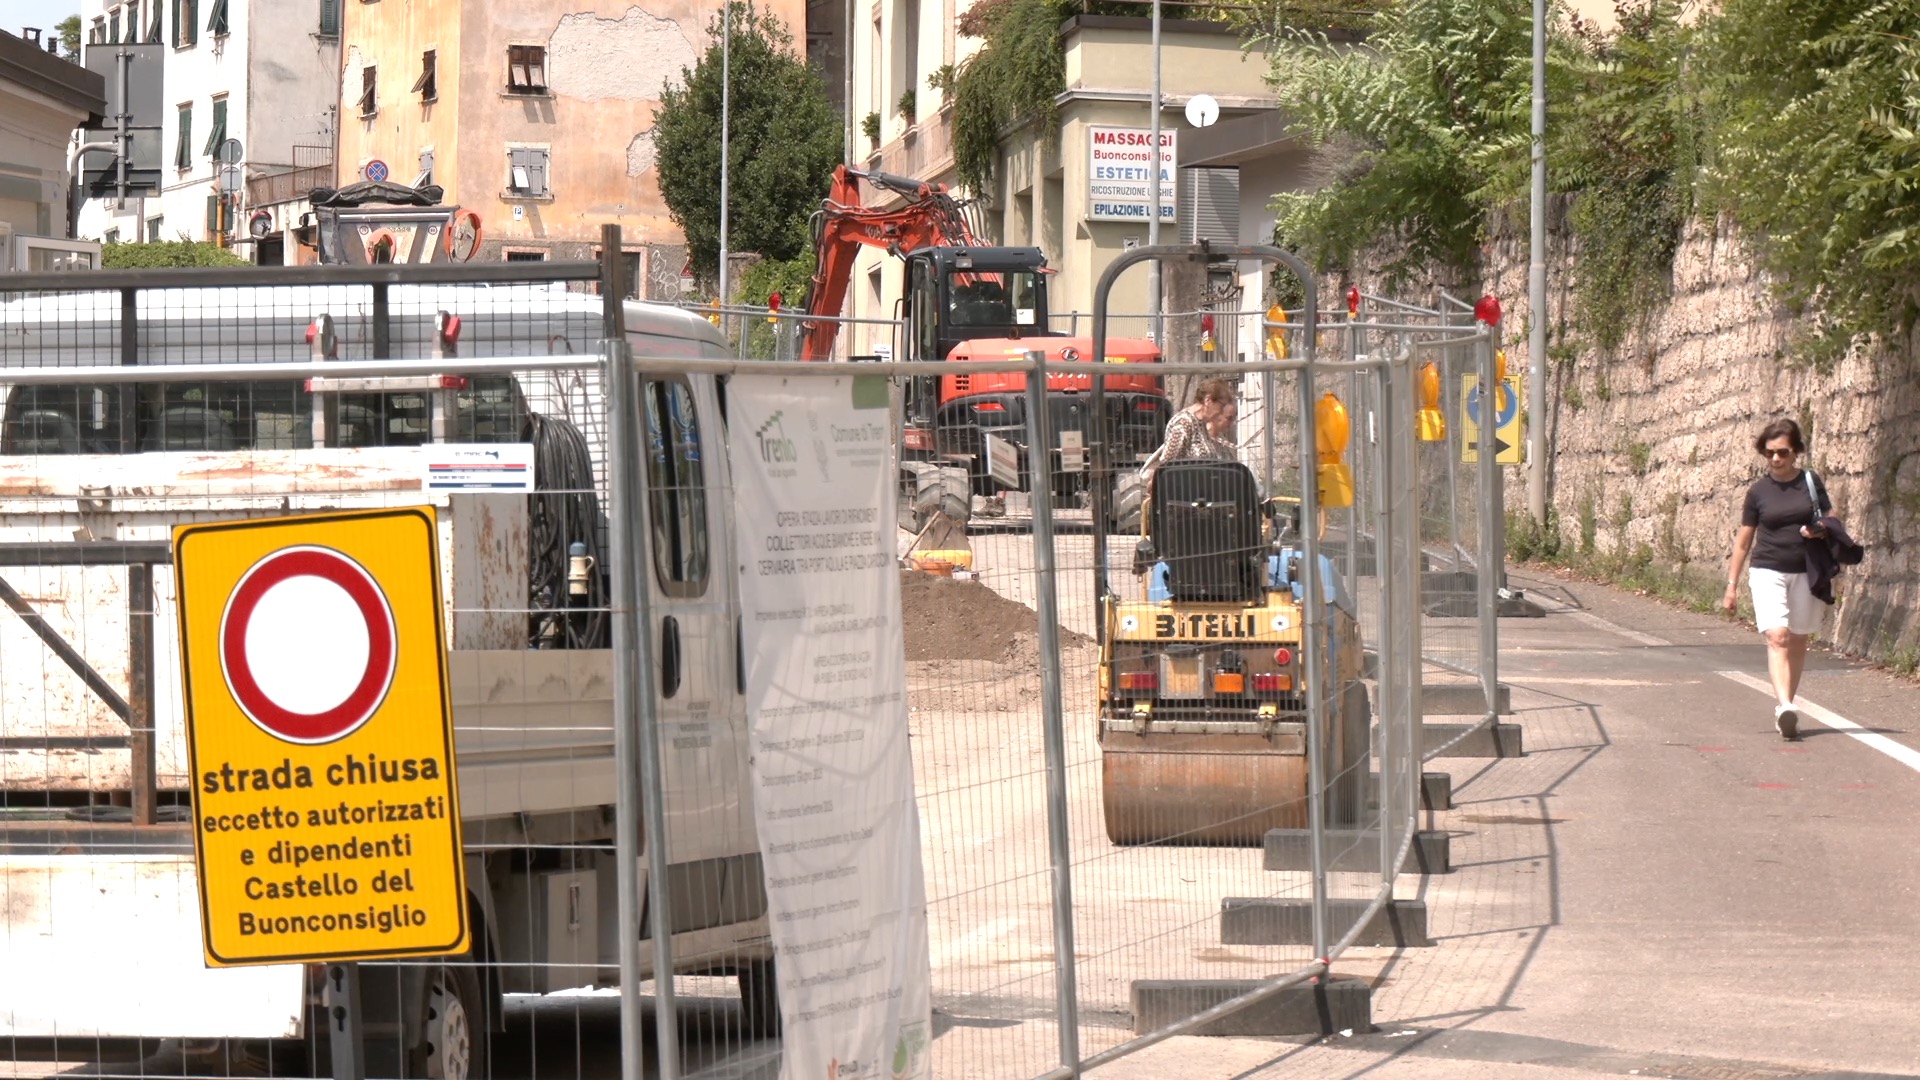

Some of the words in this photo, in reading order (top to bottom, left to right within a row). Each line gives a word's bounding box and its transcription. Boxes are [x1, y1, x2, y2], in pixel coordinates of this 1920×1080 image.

[1093, 149, 1172, 162] Buonconsilio
[1096, 166, 1169, 181] ESTETIA
[1091, 185, 1146, 197] RICOSTRUZIONE
[1094, 203, 1144, 216] EPILAZIONE
[1146, 205, 1174, 217] LSER
[203, 758, 313, 794] strada
[326, 753, 439, 786] chiusa
[203, 805, 300, 833] eccetto
[307, 796, 444, 827] autorizzati
[240, 848, 255, 866] e
[268, 833, 412, 868] dipendenti
[244, 872, 358, 901] Castello
[371, 868, 414, 894] del
[238, 904, 427, 936] Buonconsiglio
